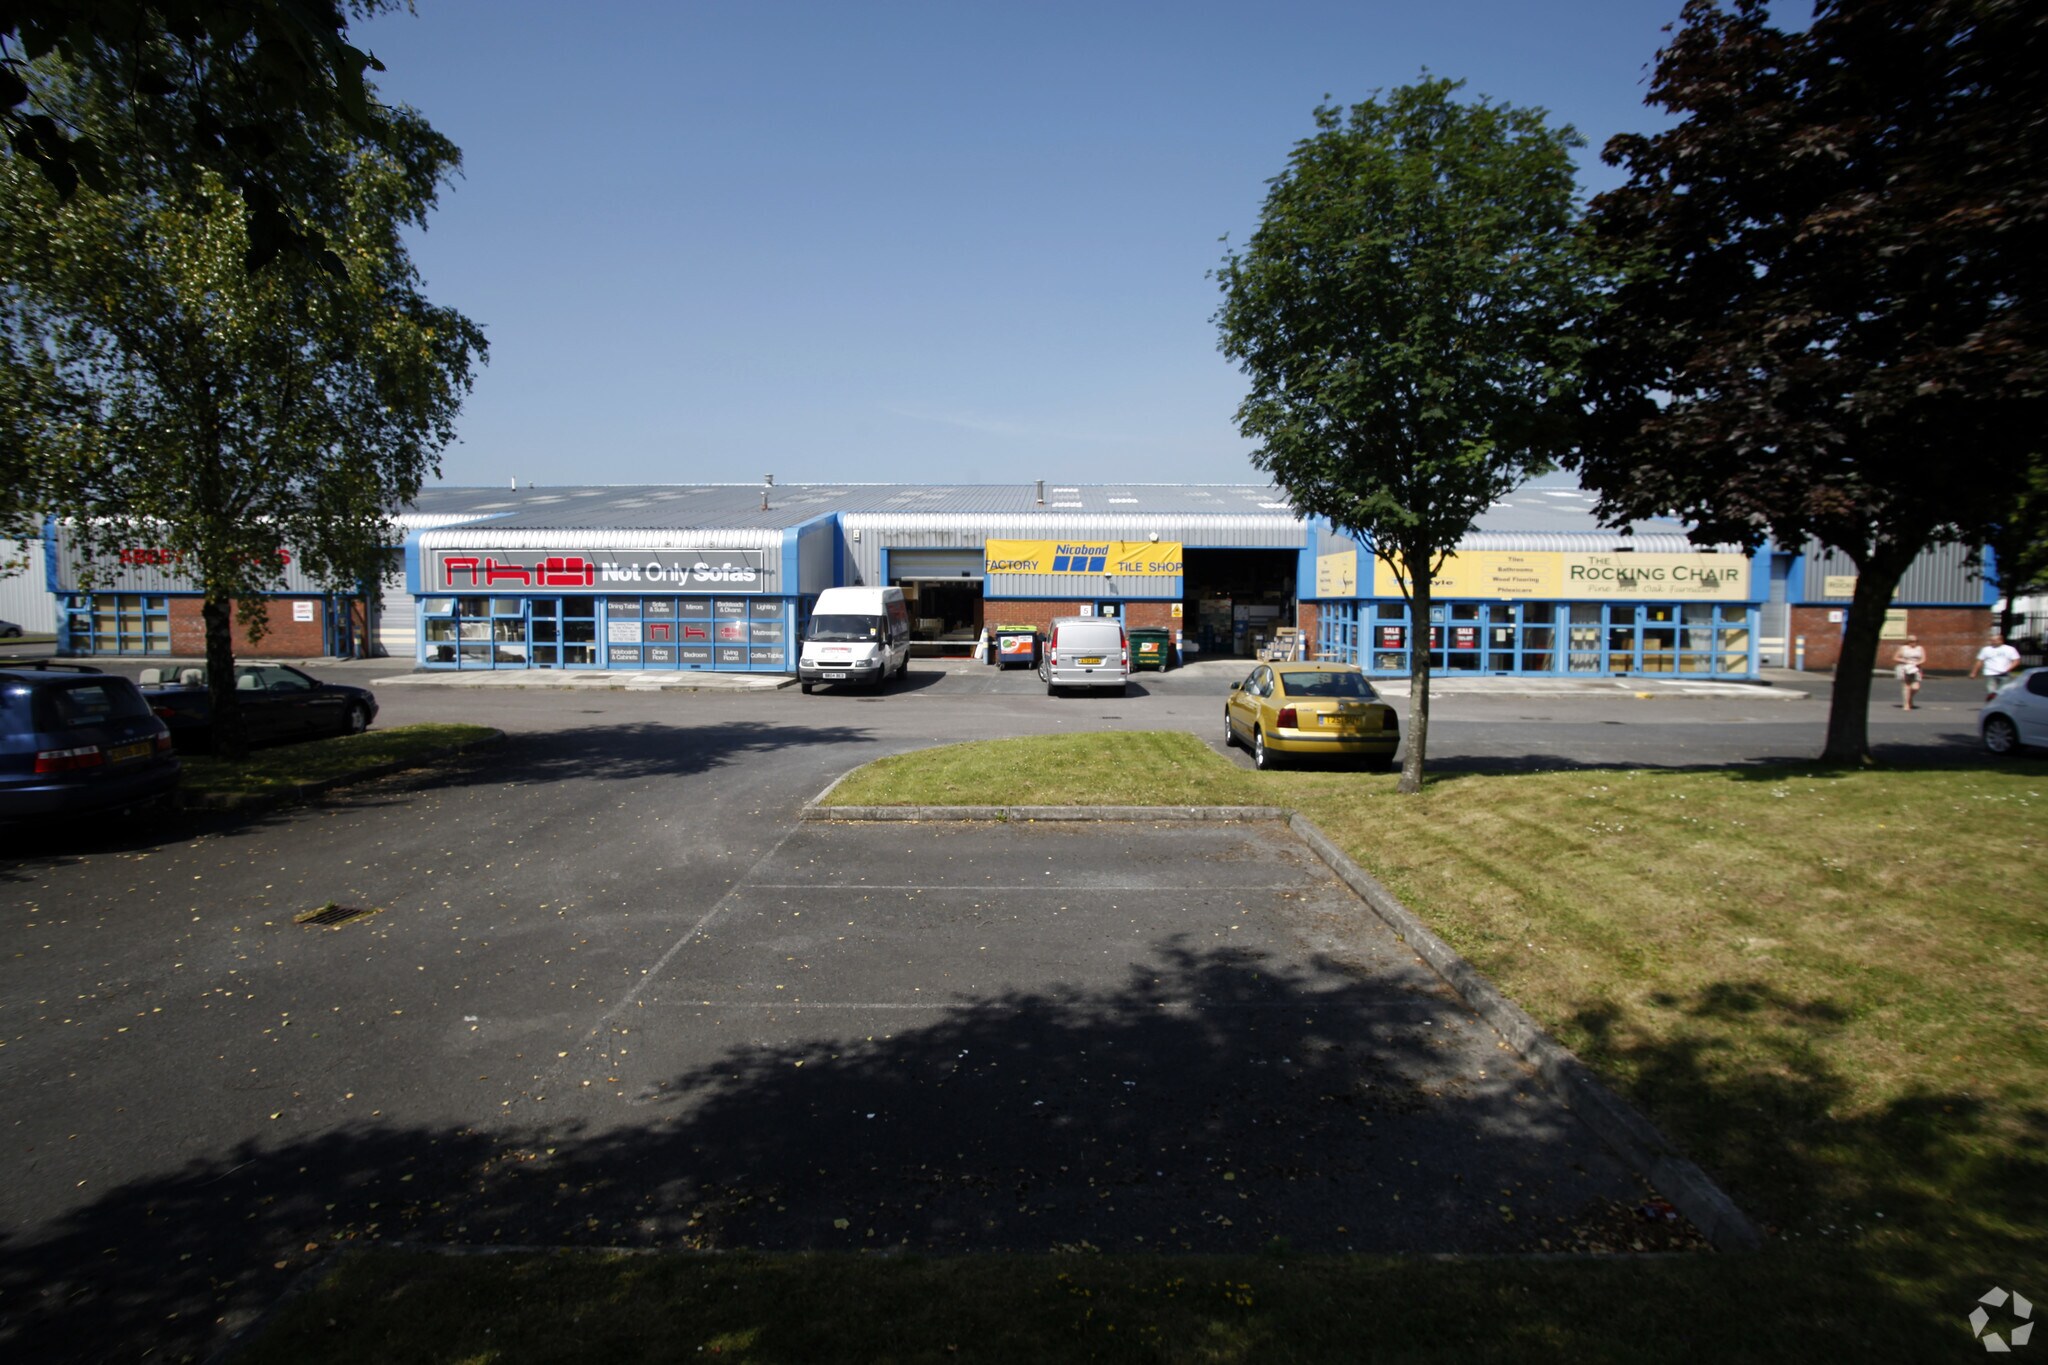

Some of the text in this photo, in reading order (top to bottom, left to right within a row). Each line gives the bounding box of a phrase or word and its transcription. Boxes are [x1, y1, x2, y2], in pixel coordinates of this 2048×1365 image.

[1056, 544, 1109, 555] Nicobond
[986, 560, 1039, 571] FACTORY
[1588, 556, 1611, 565] THE
[1118, 562, 1183, 572] TILE SHOP
[602, 562, 756, 586] Not Only Sofas
[1570, 565, 1738, 581] ROCKING CHAIR
[1588, 584, 1611, 593] Pine
[1643, 584, 1665, 593] Oak
